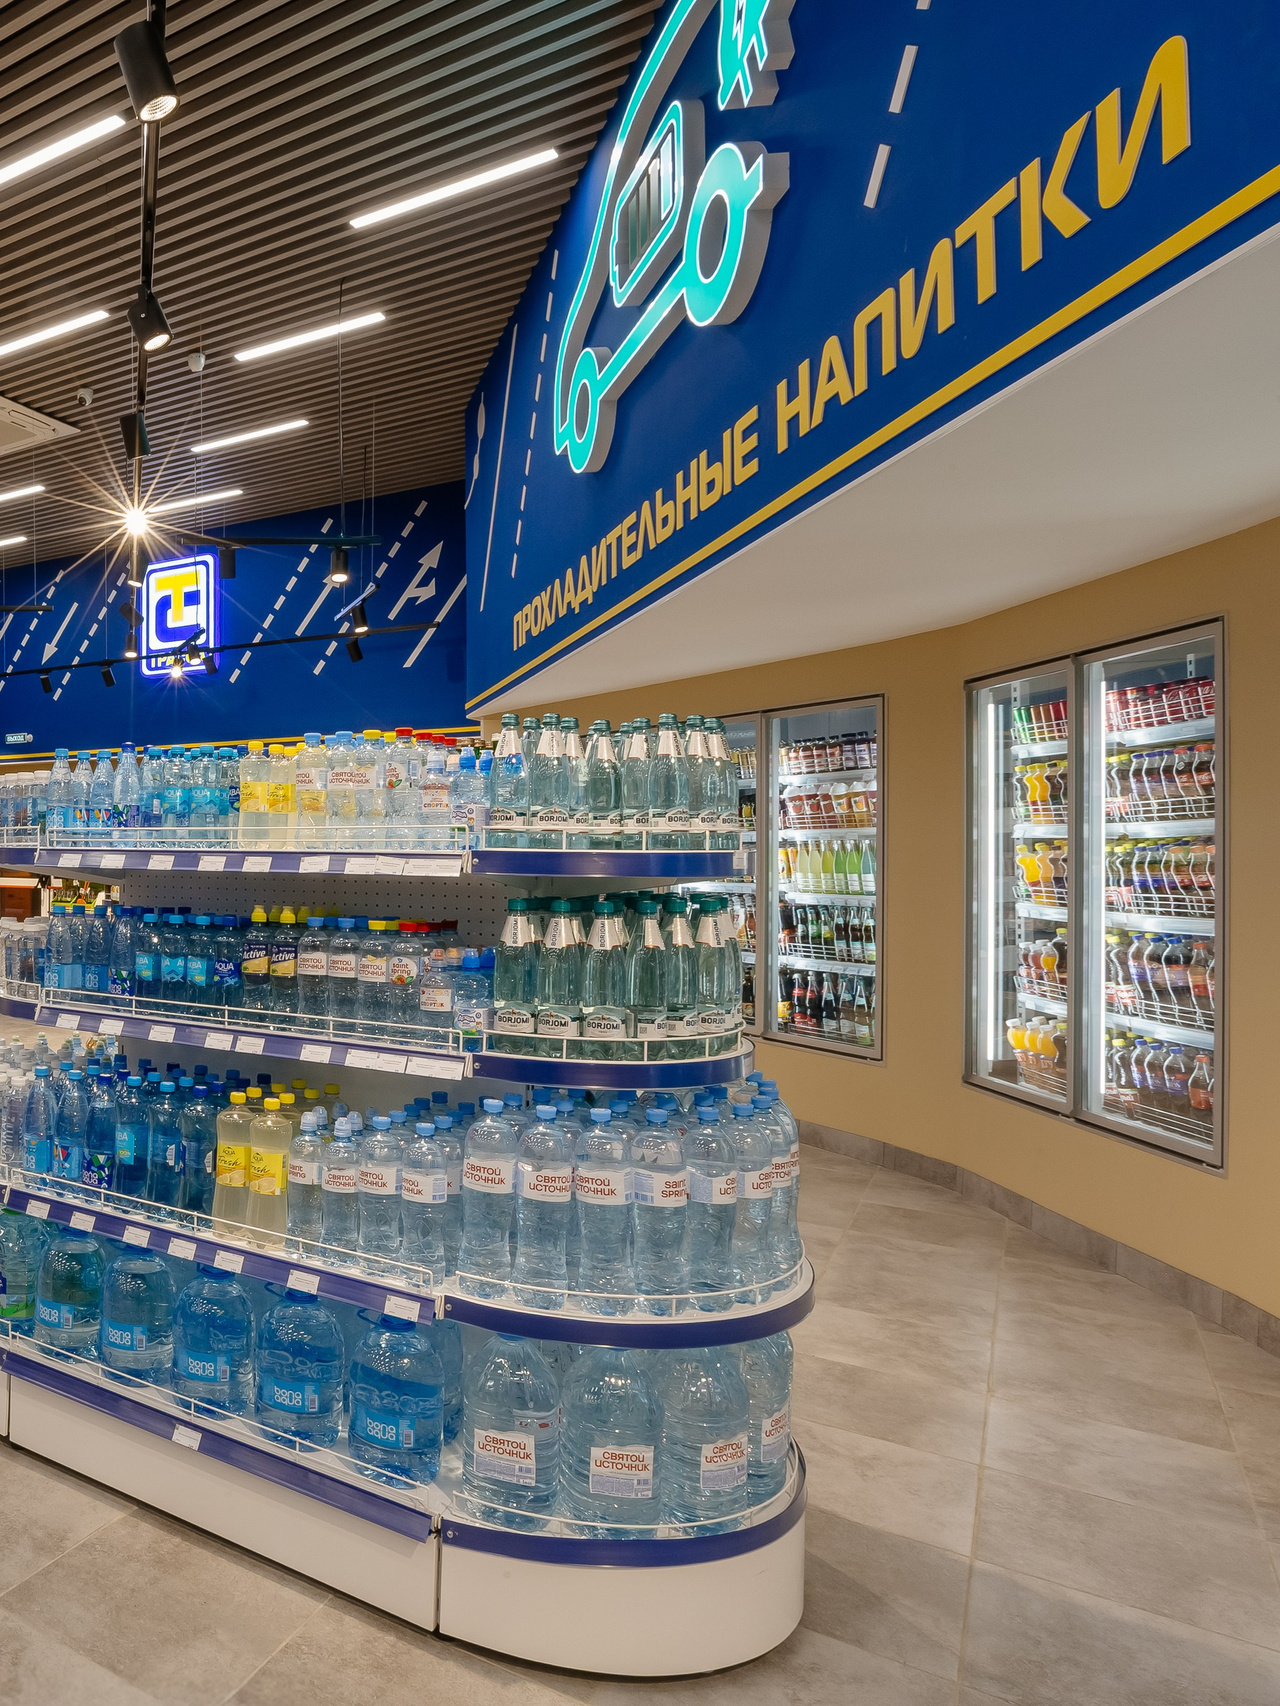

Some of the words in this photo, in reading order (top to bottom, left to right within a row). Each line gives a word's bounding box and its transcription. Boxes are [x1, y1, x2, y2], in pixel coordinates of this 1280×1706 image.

[512, 404, 760, 650] ПРОХЛАДИТЕЛЬНЫЕ
[776, 35, 1191, 454] НАПИТКИ
[551, 919, 559, 946] BORJOMI
[243, 949, 266, 959] Active
[271, 952, 295, 962] Active
[215, 961, 235, 971] AQUA
[498, 1015, 530, 1024] BORJOMI
[466, 1162, 502, 1176] СВЯТОЙ
[328, 1173, 354, 1181] СВЯТОЙ
[324, 1180, 357, 1188] ИСТОЧНИК
[39, 1303, 59, 1315] bona
[39, 1311, 59, 1323] aqua
[109, 1326, 131, 1338] bona
[109, 1333, 131, 1345] aqua
[189, 1357, 214, 1369] bona
[189, 1366, 214, 1377] aqua
[274, 1385, 302, 1399] bona
[274, 1395, 302, 1407] aqua
[367, 1416, 396, 1432] bona
[367, 1426, 396, 1442] aqua
[485, 1434, 526, 1451] СВЯТОЙ
[712, 1441, 743, 1454] СВЯТОЙ
[478, 1440, 532, 1461] ИСТОЧНИК
[705, 1449, 746, 1464] ИСТОЧНИК
[602, 1451, 645, 1463] СВЯТОЙ
[594, 1460, 650, 1472] ИСТОЧНИК
